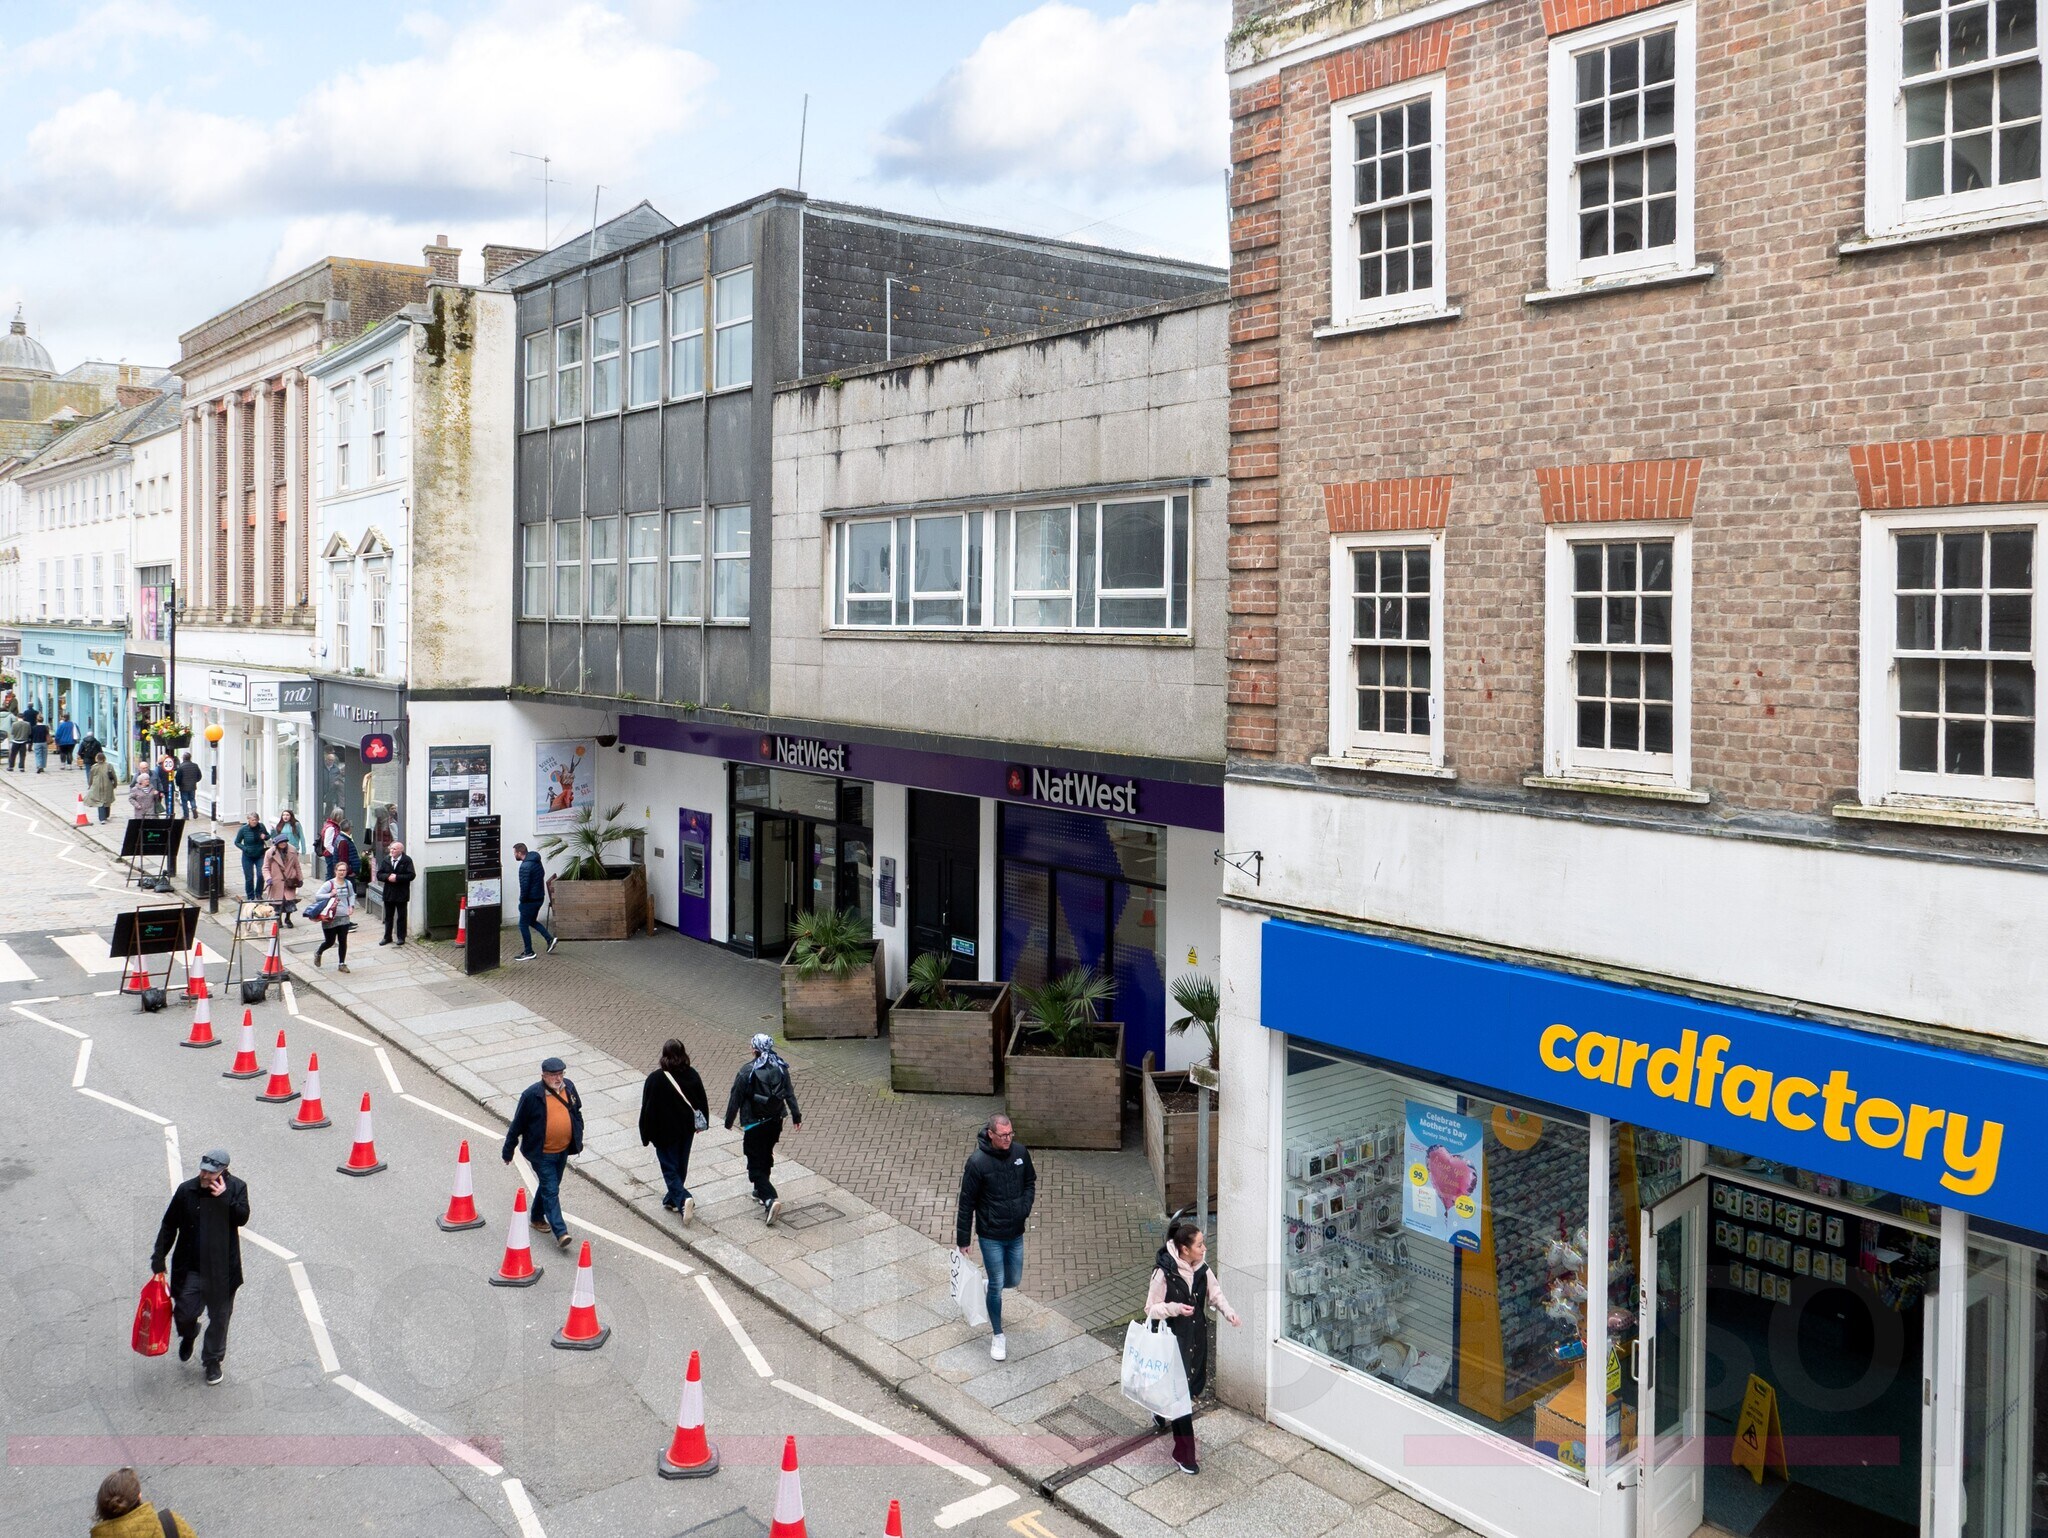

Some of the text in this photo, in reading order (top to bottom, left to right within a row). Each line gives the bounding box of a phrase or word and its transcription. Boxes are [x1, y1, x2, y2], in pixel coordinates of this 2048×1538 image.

[333, 703, 379, 725] MINT VELVET
[776, 735, 846, 772] NatWest
[164, 760, 173, 768] 20
[1031, 768, 1138, 815] NatWest
[1538, 1023, 2004, 1197] cardfactory
[1426, 1111, 1461, 1129] Celebrate
[1420, 1118, 1468, 1141] Mother's Day
[1422, 1129, 1439, 1140] Sunday
[1450, 1138, 1464, 1146] March
[1413, 1170, 1425, 1182] 99p
[1715, 1191, 1725, 1205] 0
[1730, 1195, 1737, 1210] 1
[1455, 1202, 1474, 1213] £2.99
[1744, 1200, 1754, 1215] 2
[1760, 1203, 1770, 1218] 3
[1787, 1213, 1797, 1229] 5
[1807, 1218, 1818, 1234] 6
[1829, 1224, 1839, 1240] 7
[1748, 1238, 1757, 1253] 0
[1777, 1246, 1786, 1261] 2
[1796, 1254, 1807, 1269] 3
